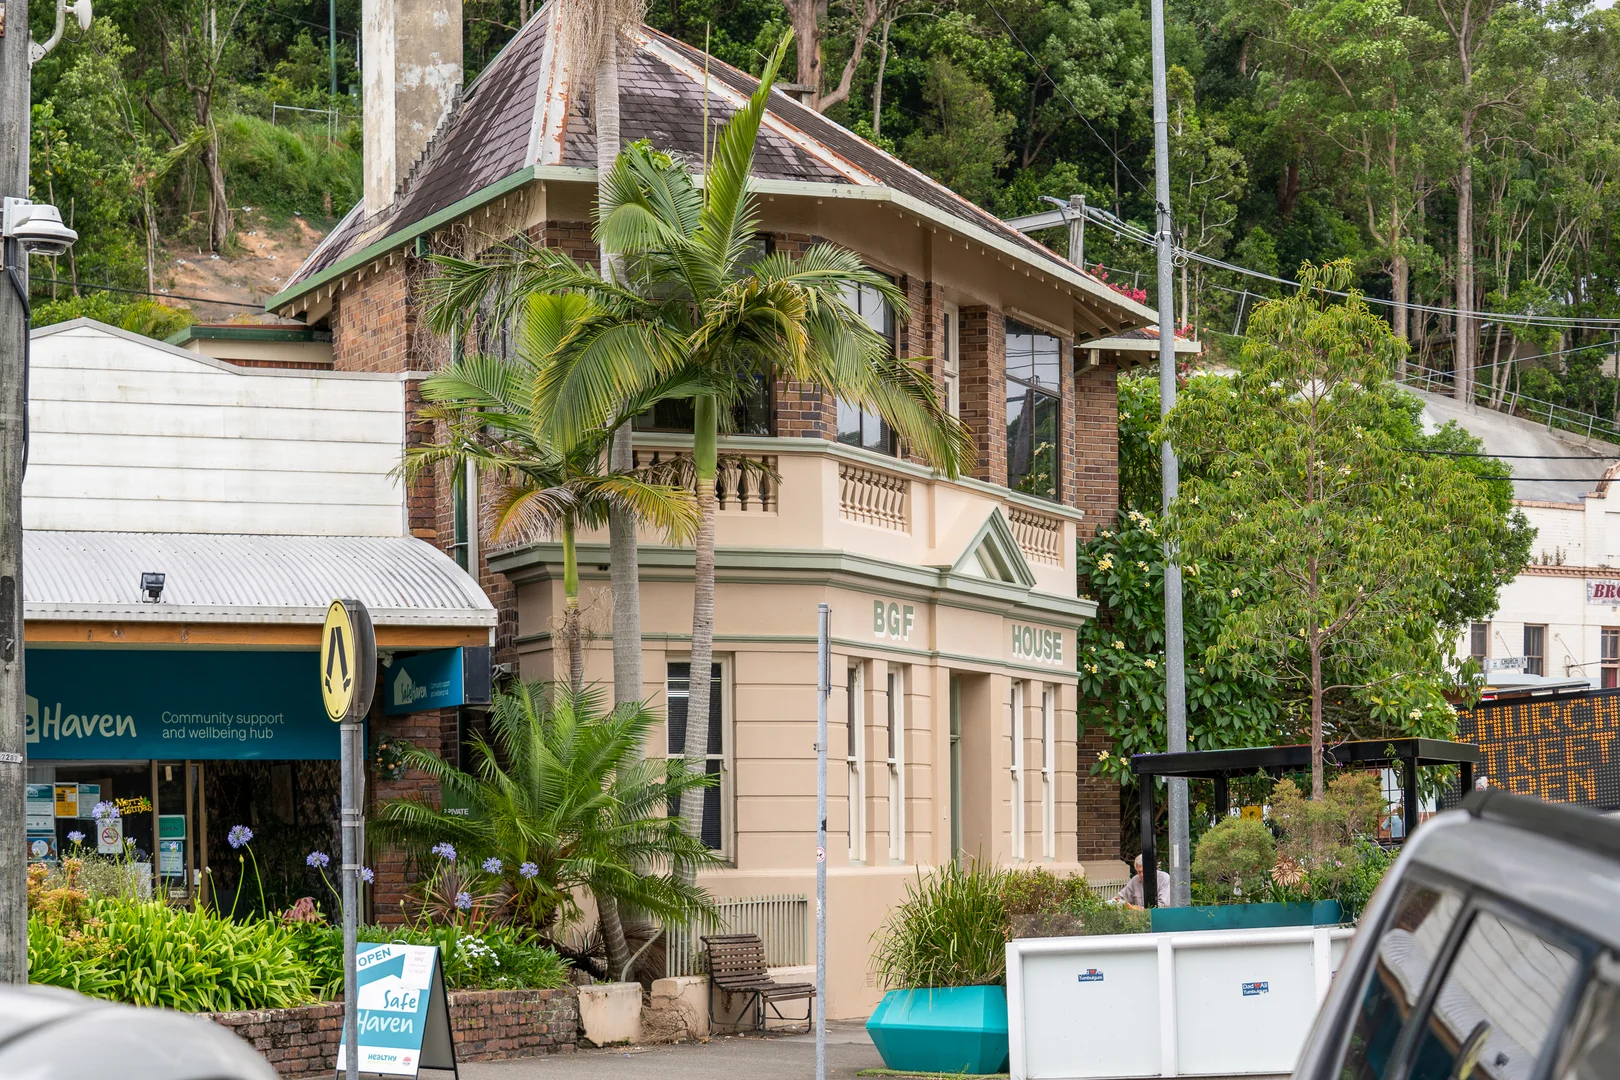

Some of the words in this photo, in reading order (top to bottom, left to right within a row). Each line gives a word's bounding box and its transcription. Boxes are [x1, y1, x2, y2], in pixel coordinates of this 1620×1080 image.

[873, 599, 915, 641] BGF
[1011, 623, 1064, 665] HOUSE
[42, 702, 137, 741] Haven
[161, 711, 234, 726] Community
[236, 712, 284, 726] support
[162, 727, 186, 739] and
[188, 727, 247, 741] wellbeing
[249, 727, 274, 739] hub
[1470, 731, 1617, 780] TREET
[115, 796, 144, 807] Merry
[118, 803, 153, 815] ristmas
[358, 947, 391, 967] OPEN
[383, 989, 417, 1010] Safe
[357, 1010, 413, 1035] Haven
